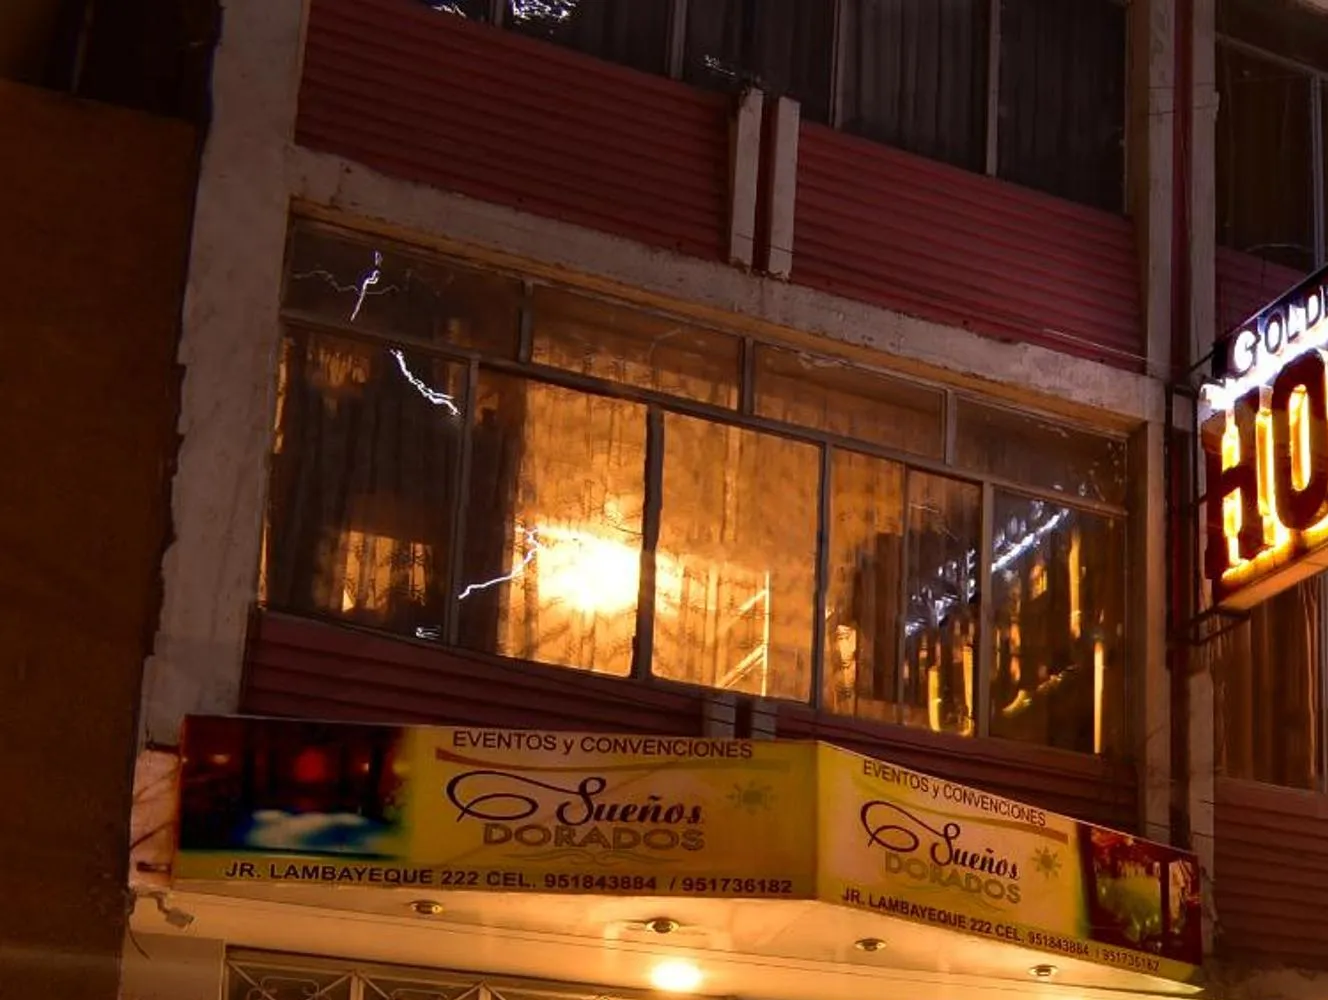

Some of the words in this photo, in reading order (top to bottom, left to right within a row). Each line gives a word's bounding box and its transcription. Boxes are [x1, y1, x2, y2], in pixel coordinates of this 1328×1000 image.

[452, 730, 556, 752] EVENTOS
[563, 737, 575, 755] y
[580, 736, 753, 759] CONVENCIONES
[446, 770, 703, 826] Sueños
[863, 760, 928, 794] EVENTOS
[933, 784, 940, 800] y
[943, 784, 1046, 828] CONVENCIONES
[483, 823, 705, 852] DORADOS
[860, 800, 1020, 881] Sueños
[225, 862, 261, 879] JR.
[269, 864, 434, 885] LAMBAYEQUE
[440, 870, 480, 885] 222
[486, 871, 536, 888] CEL.
[544, 873, 658, 890] 951843884
[682, 877, 793, 894] 951736182
[884, 850, 1022, 905] DORADOS
[842, 888, 866, 906] JR.
[868, 894, 967, 930] LAMBAYEQUE
[970, 917, 992, 934] 222
[994, 923, 1026, 944] CEL.
